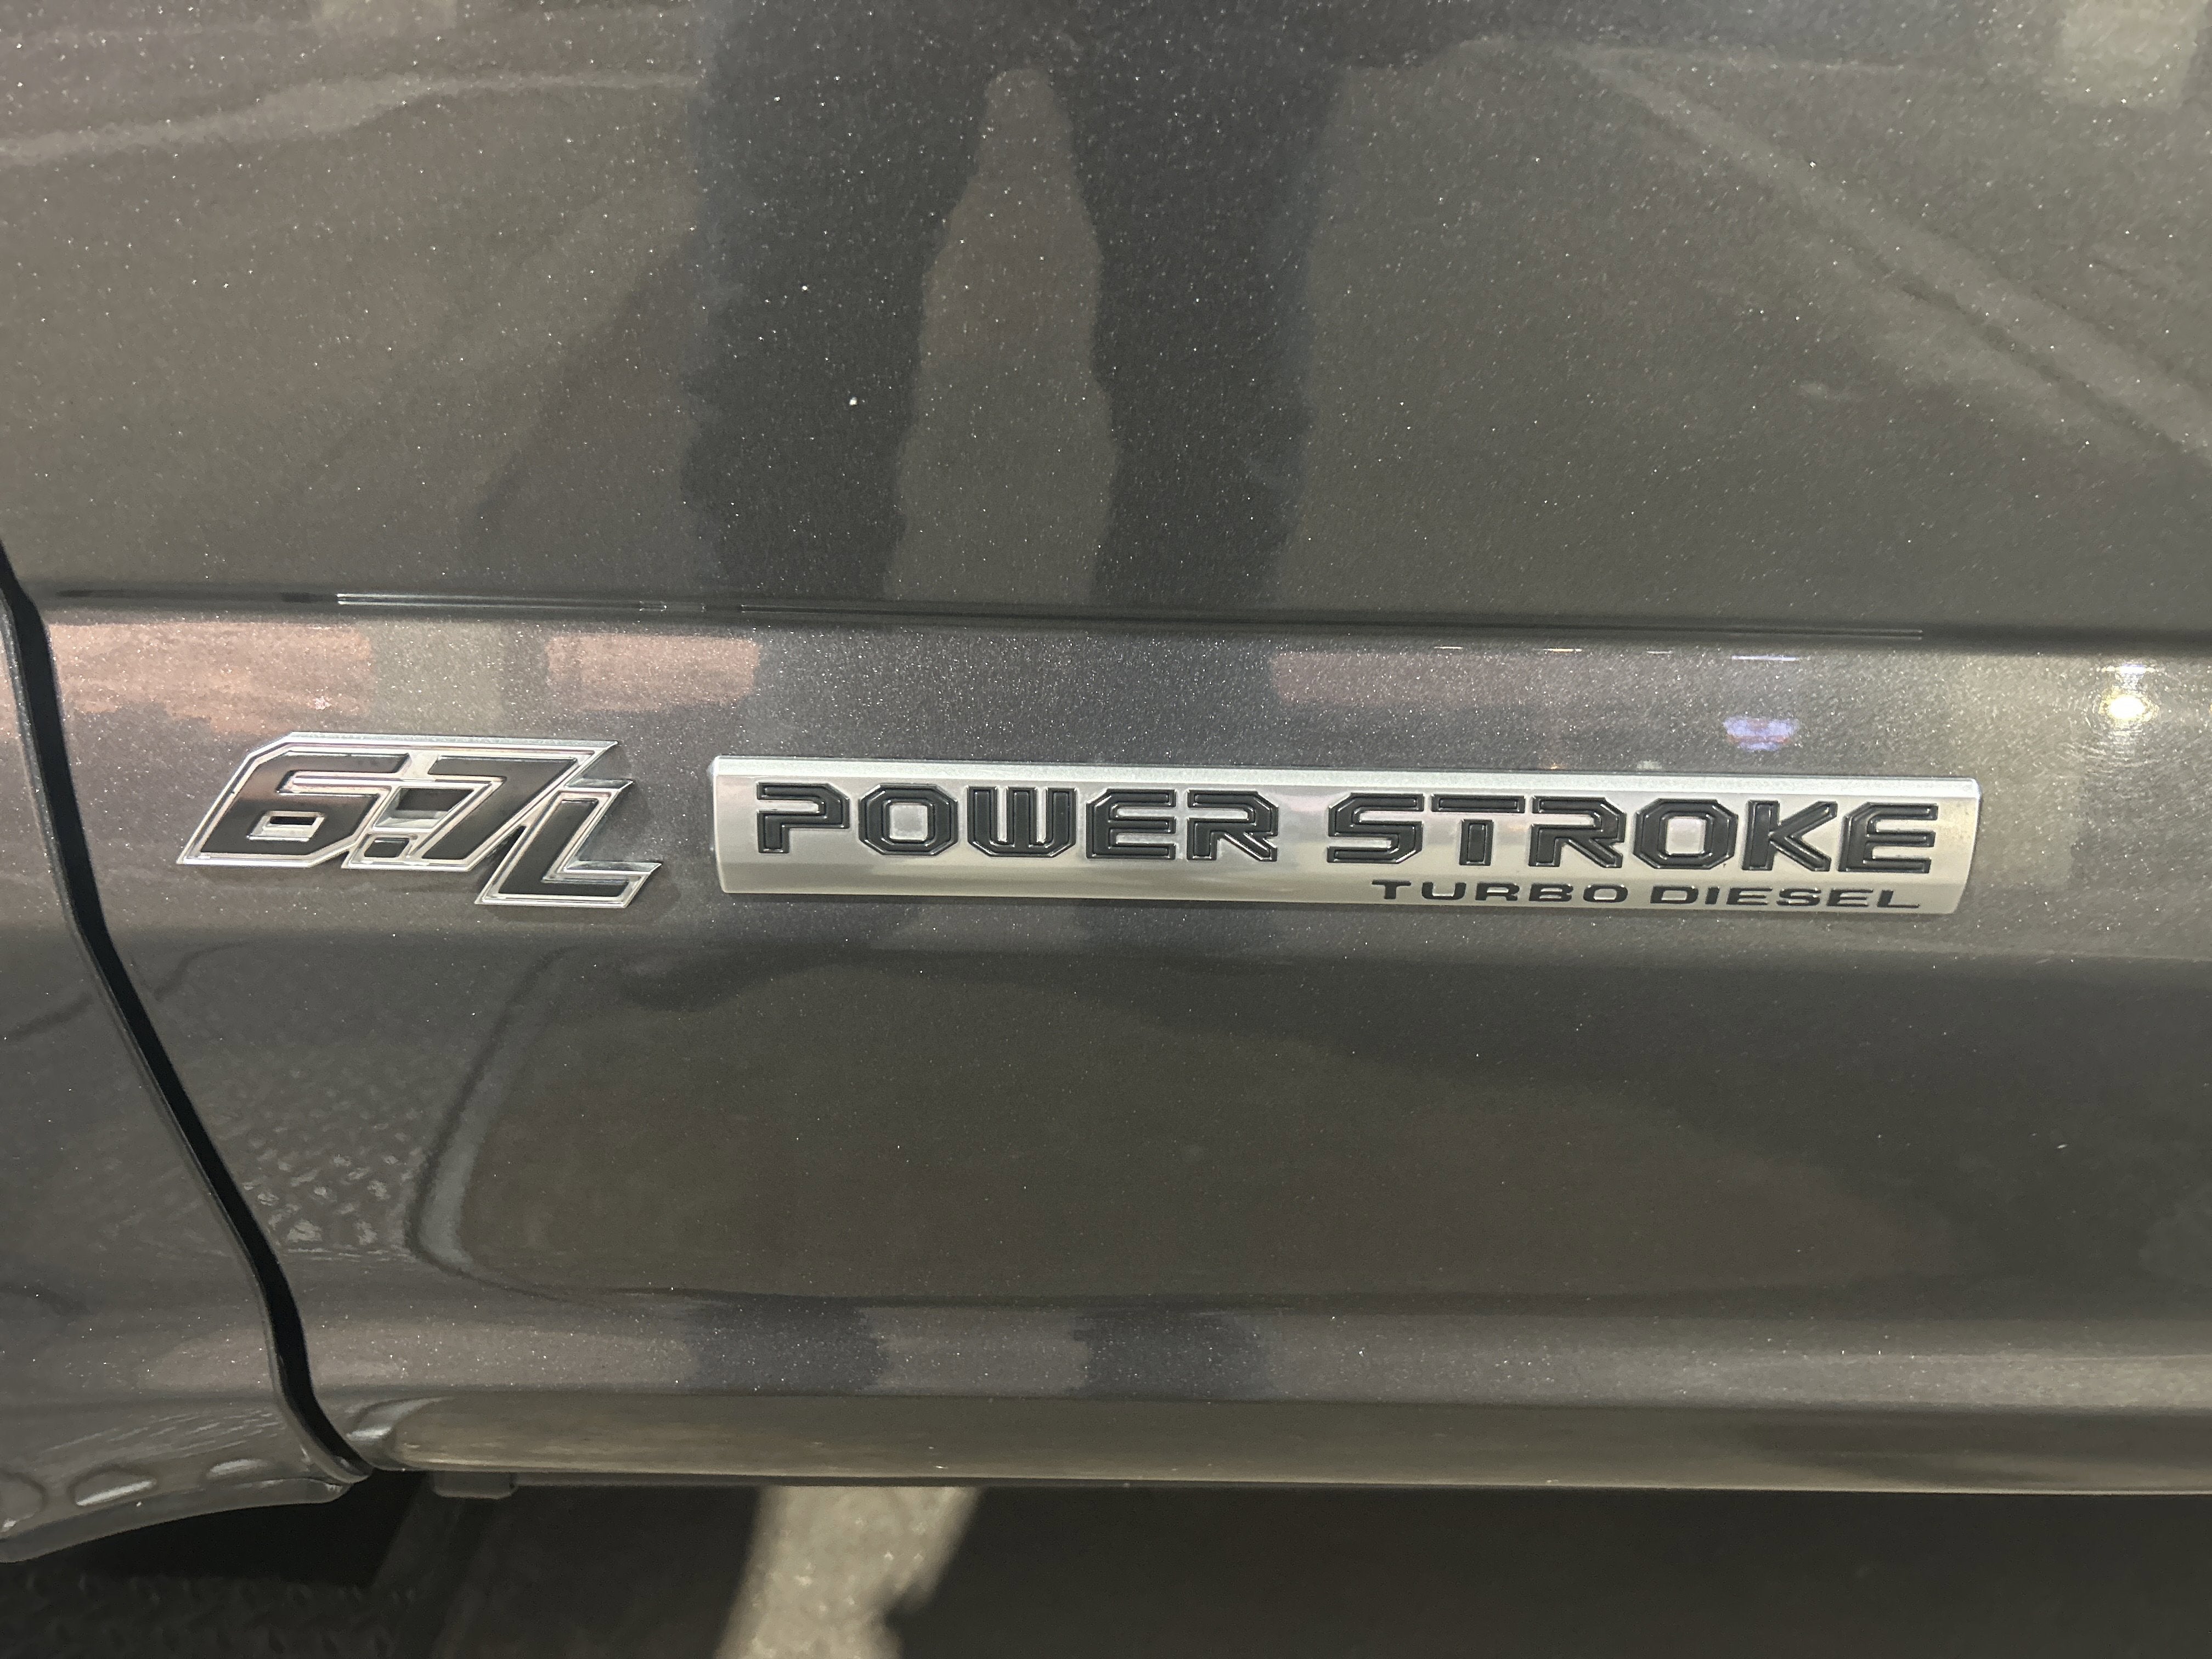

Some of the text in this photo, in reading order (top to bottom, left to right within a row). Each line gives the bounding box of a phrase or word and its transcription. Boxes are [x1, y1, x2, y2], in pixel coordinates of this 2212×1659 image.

[177, 732, 662, 908] 6.7L
[756, 782, 1938, 873] POWER STROKE
[1372, 879, 1920, 909] TURBO DIESEL
